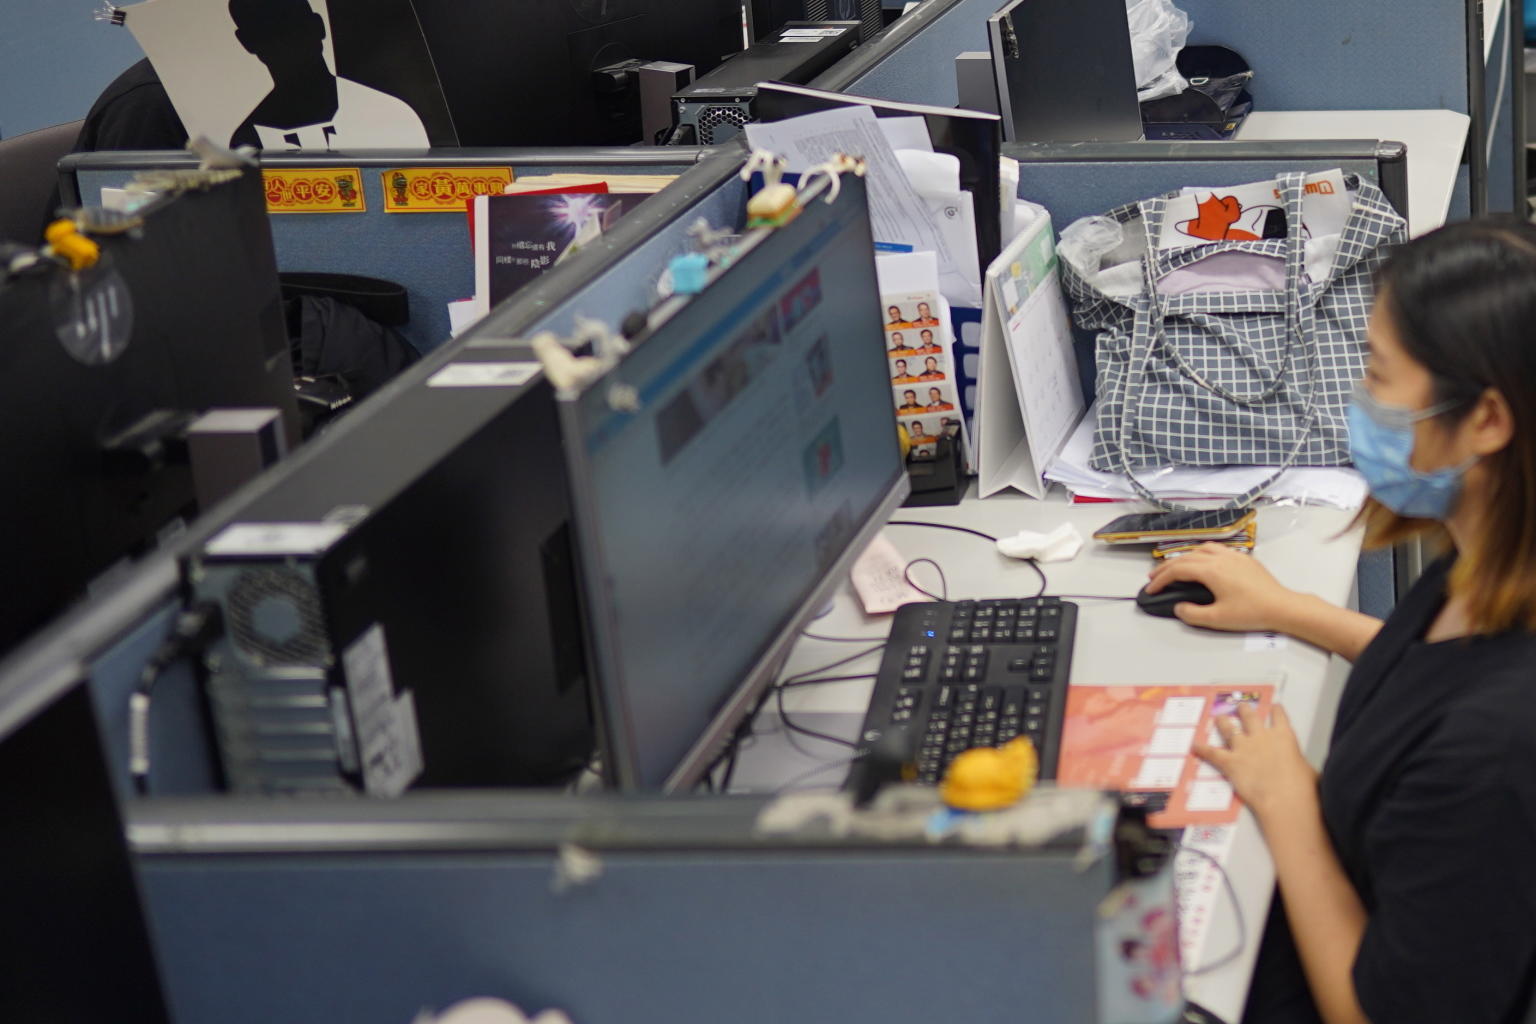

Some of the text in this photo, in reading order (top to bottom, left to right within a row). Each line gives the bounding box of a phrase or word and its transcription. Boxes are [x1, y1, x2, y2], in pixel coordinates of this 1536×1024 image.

[265, 178, 333, 201] 人一世平安
